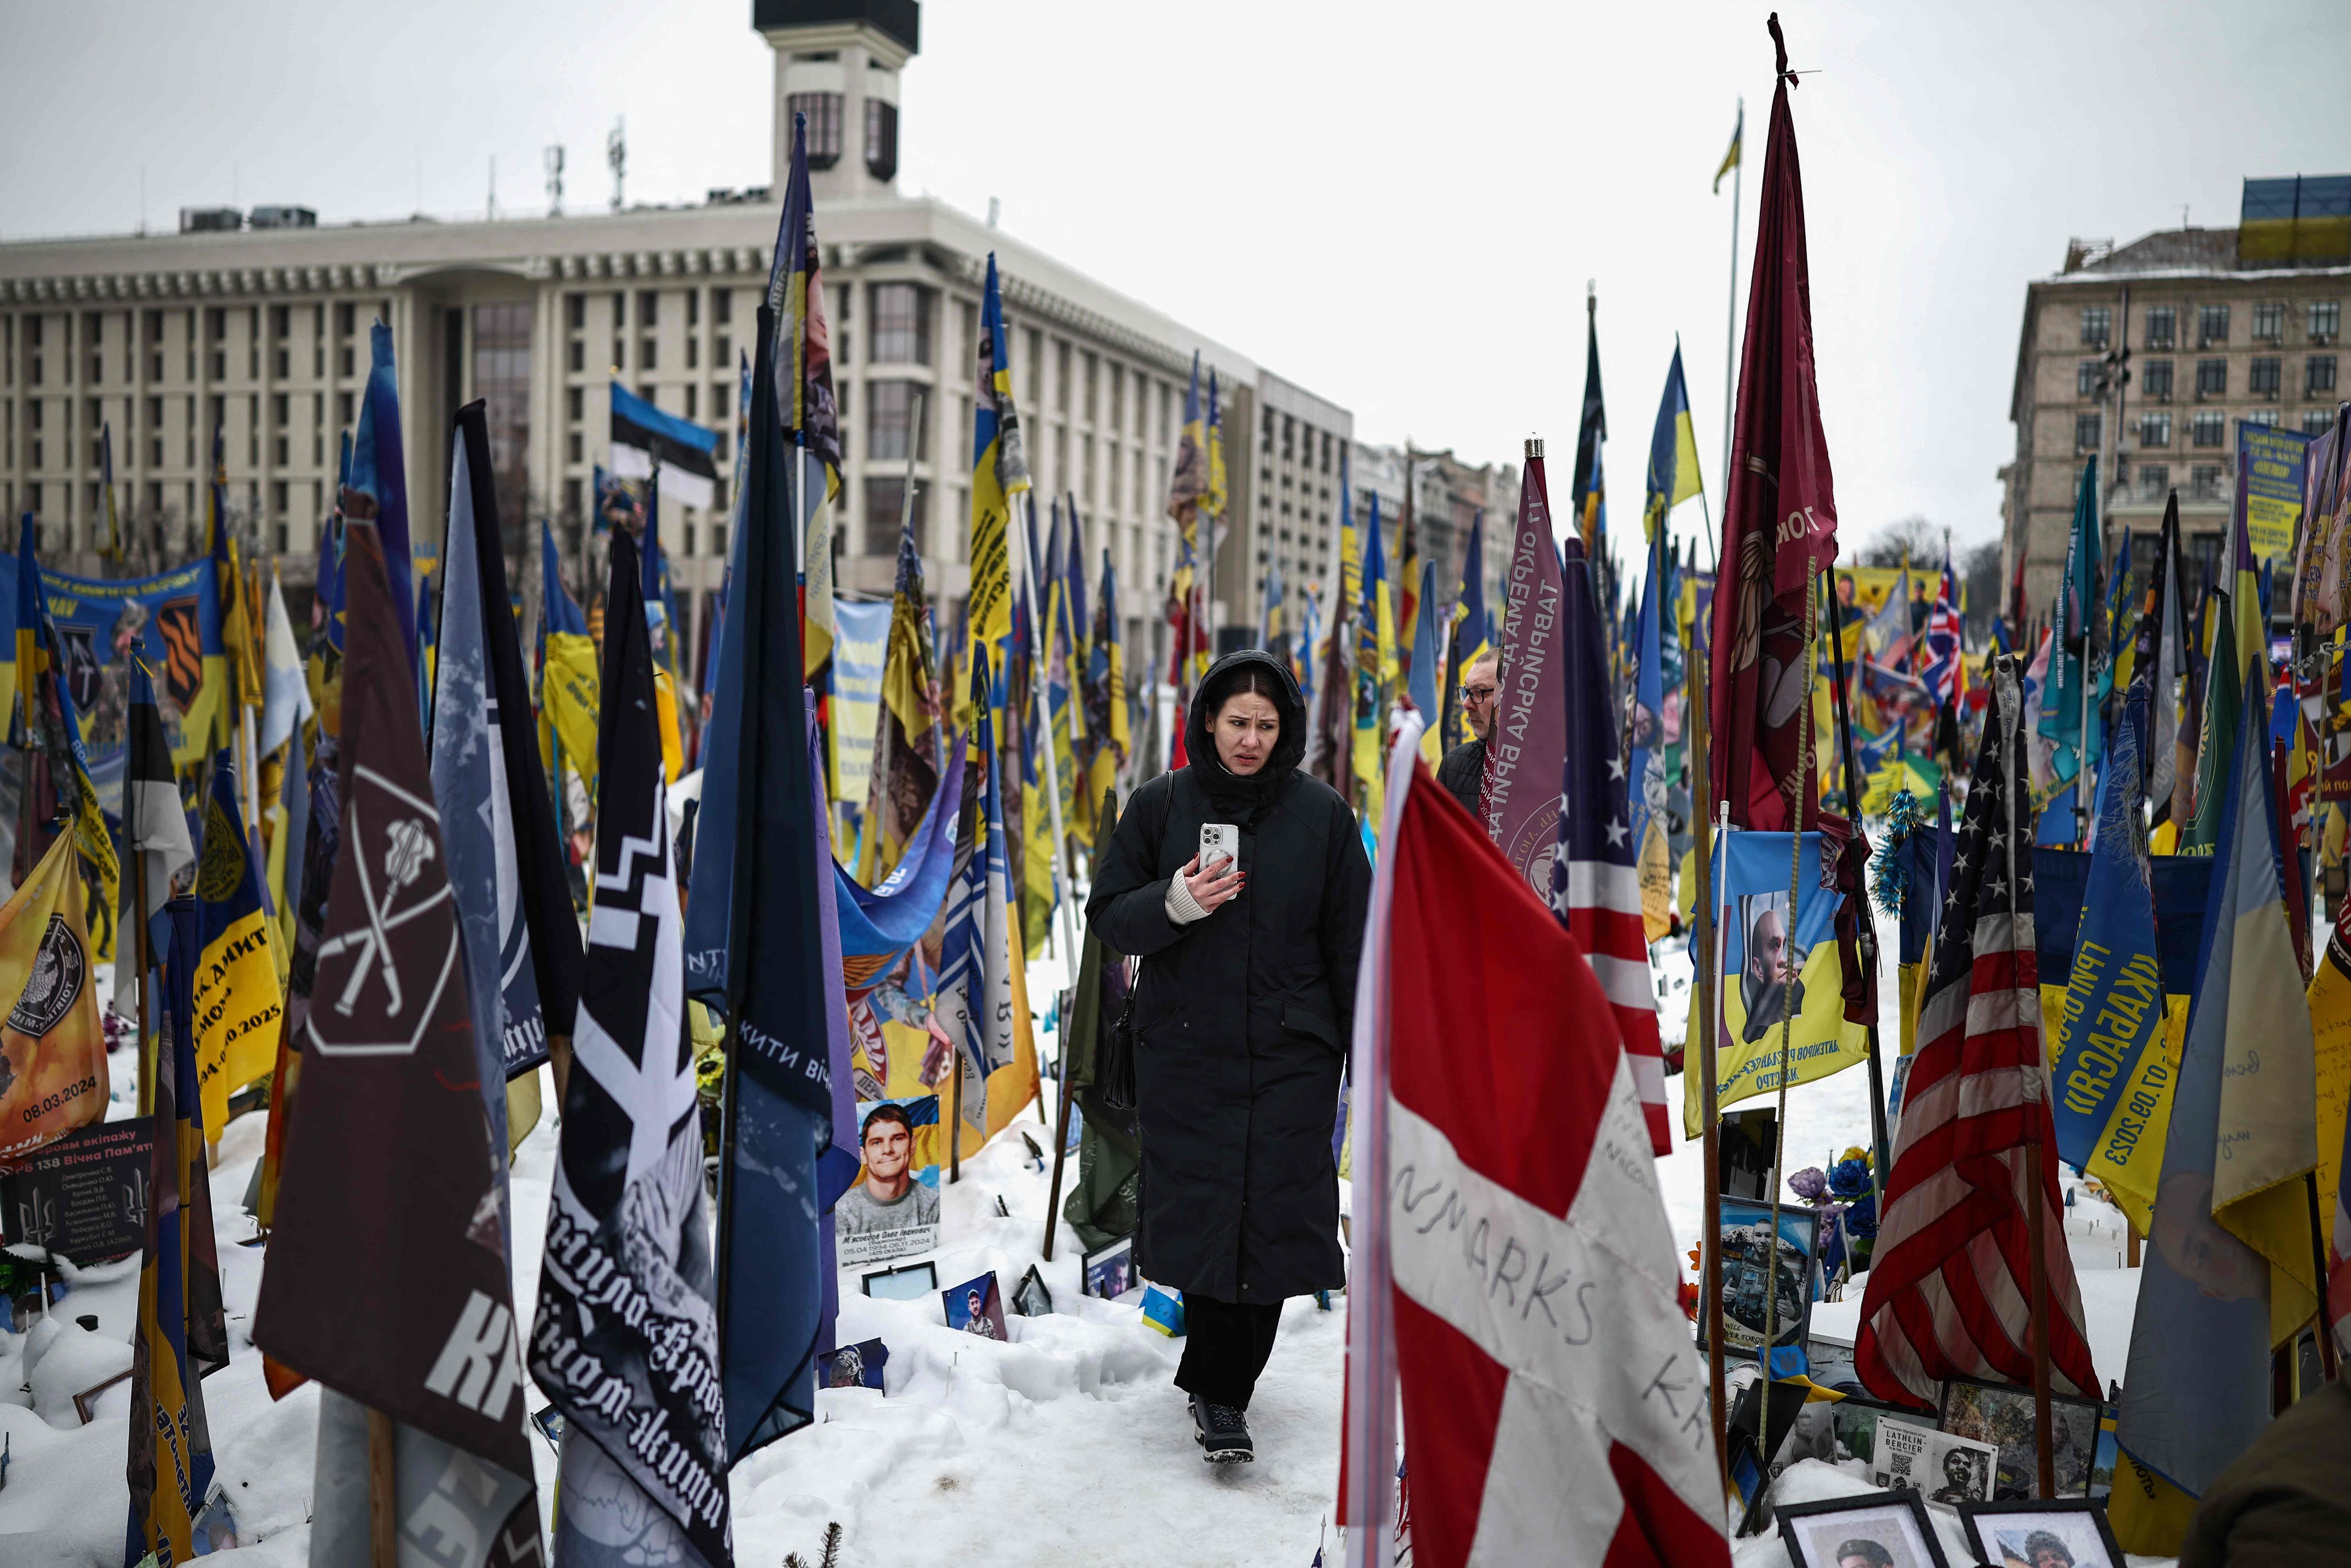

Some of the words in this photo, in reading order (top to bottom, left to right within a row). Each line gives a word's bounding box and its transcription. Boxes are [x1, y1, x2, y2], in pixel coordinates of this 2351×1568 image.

[22, 1075, 98, 1124] 08.03.2024
[37, 1141, 80, 1156] ероям
[36, 1158, 60, 1170] 138
[64, 1152, 102, 1166] Вічна
[1725, 1322, 1741, 1331] WILL
[1726, 1330, 1740, 1340] VER
[1741, 1334, 1766, 1345] FORGE
[1883, 1423, 1903, 1433] Remember
[1886, 1438, 1922, 1454] BERCIER
